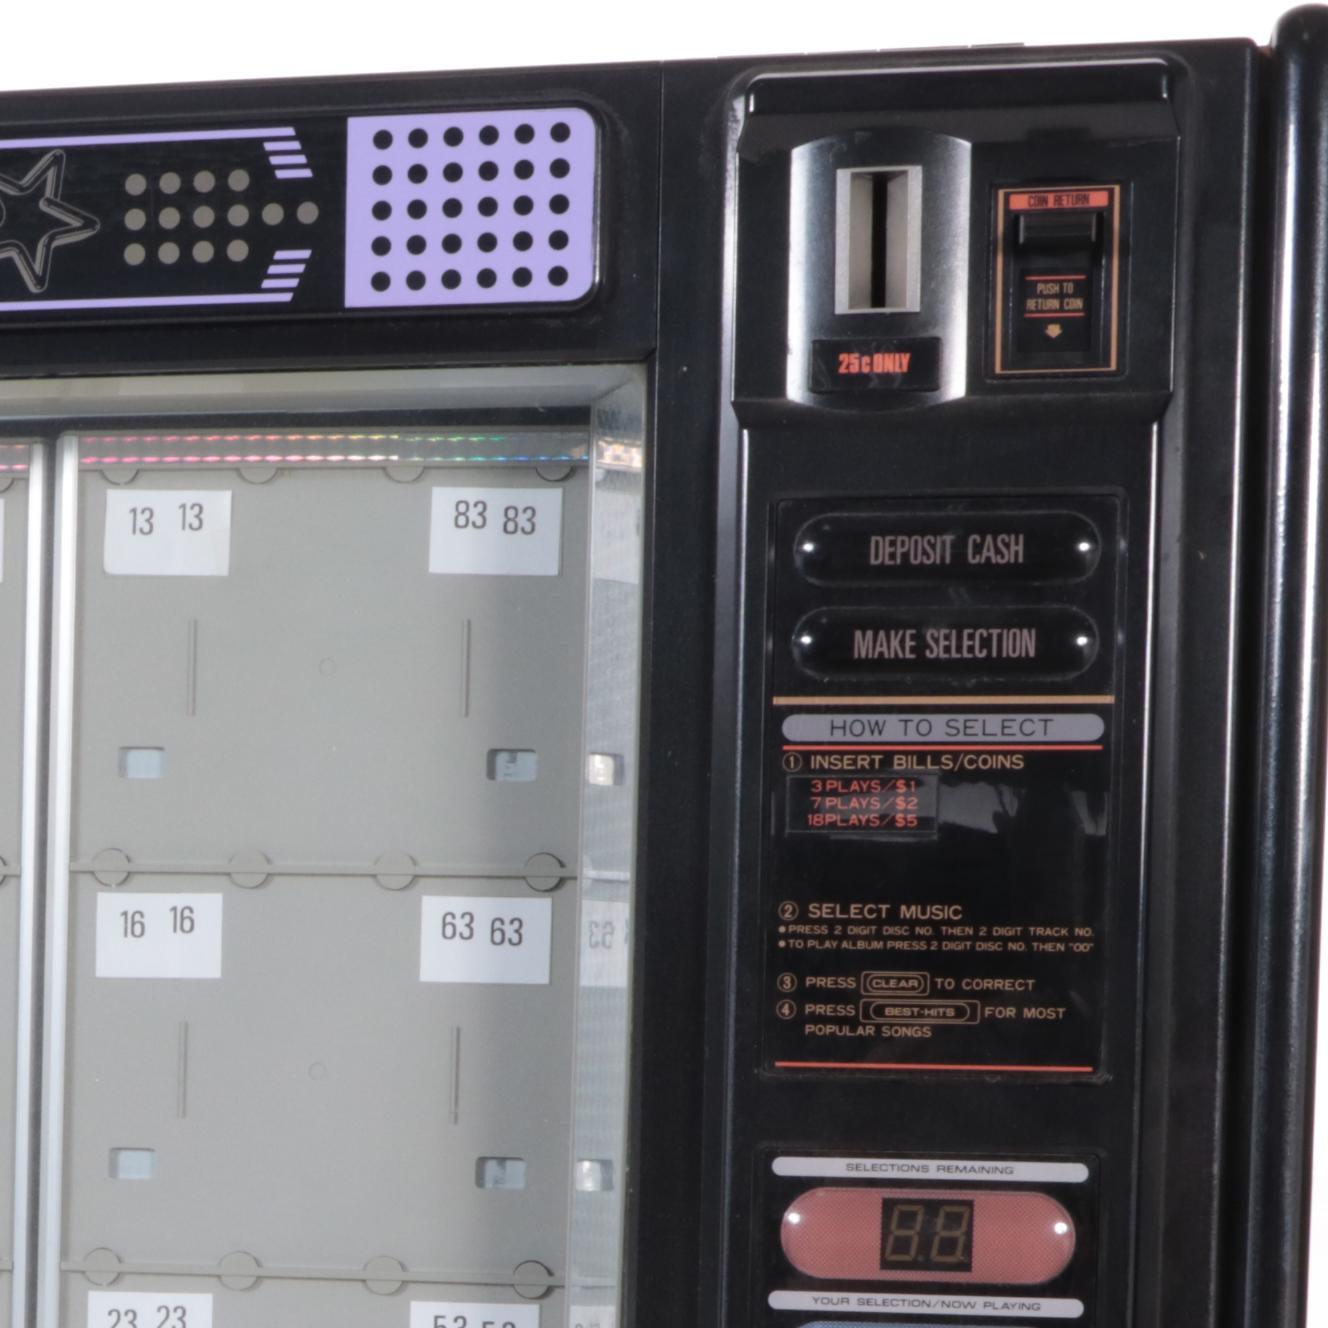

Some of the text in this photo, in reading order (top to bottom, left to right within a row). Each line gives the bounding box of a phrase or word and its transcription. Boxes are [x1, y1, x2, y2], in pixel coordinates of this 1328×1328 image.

[1027, 195, 1090, 207] COIN RETURN
[1037, 282, 1074, 295] PUSH TO
[1026, 298, 1083, 310] RETURN COIN
[873, 353, 911, 373] ONLY
[129, 503, 203, 535] 13 13
[454, 500, 536, 535] 83 83
[870, 534, 1025, 565] DEPOSIT CASH
[853, 628, 1036, 659] MAKE SELECTION
[830, 718, 1054, 737] HOW TO SELECT
[810, 755, 884, 770] INSERT
[893, 755, 1024, 771] BILLS/COINS
[808, 903, 890, 919] SELECT
[900, 904, 962, 920] MUSIC
[120, 906, 195, 938] 16 16
[441, 911, 523, 946] 63 63
[788, 925, 1094, 937] PRESS 2 DIGIT DISC NO. THEN 2 DIGIT TRACK NO.
[788, 939, 1094, 952] TO PLAY ALBUM PRESS 2 DIGIT DISC NO. THEN "00"
[805, 976, 856, 989] PRESS
[872, 978, 919, 988] CLEAR
[935, 978, 955, 990] TO
[962, 978, 1036, 991] CORRECT
[805, 1004, 856, 1016] PRESS
[984, 1006, 1016, 1018] FOR
[1023, 1007, 1066, 1019] MOST
[805, 1024, 932, 1038] POPULAR SONGS
[846, 1162, 1014, 1175] SELECTIONS REMAINING
[812, 1295, 1041, 1312] YOUR SELECTION/NOW PLAYING
